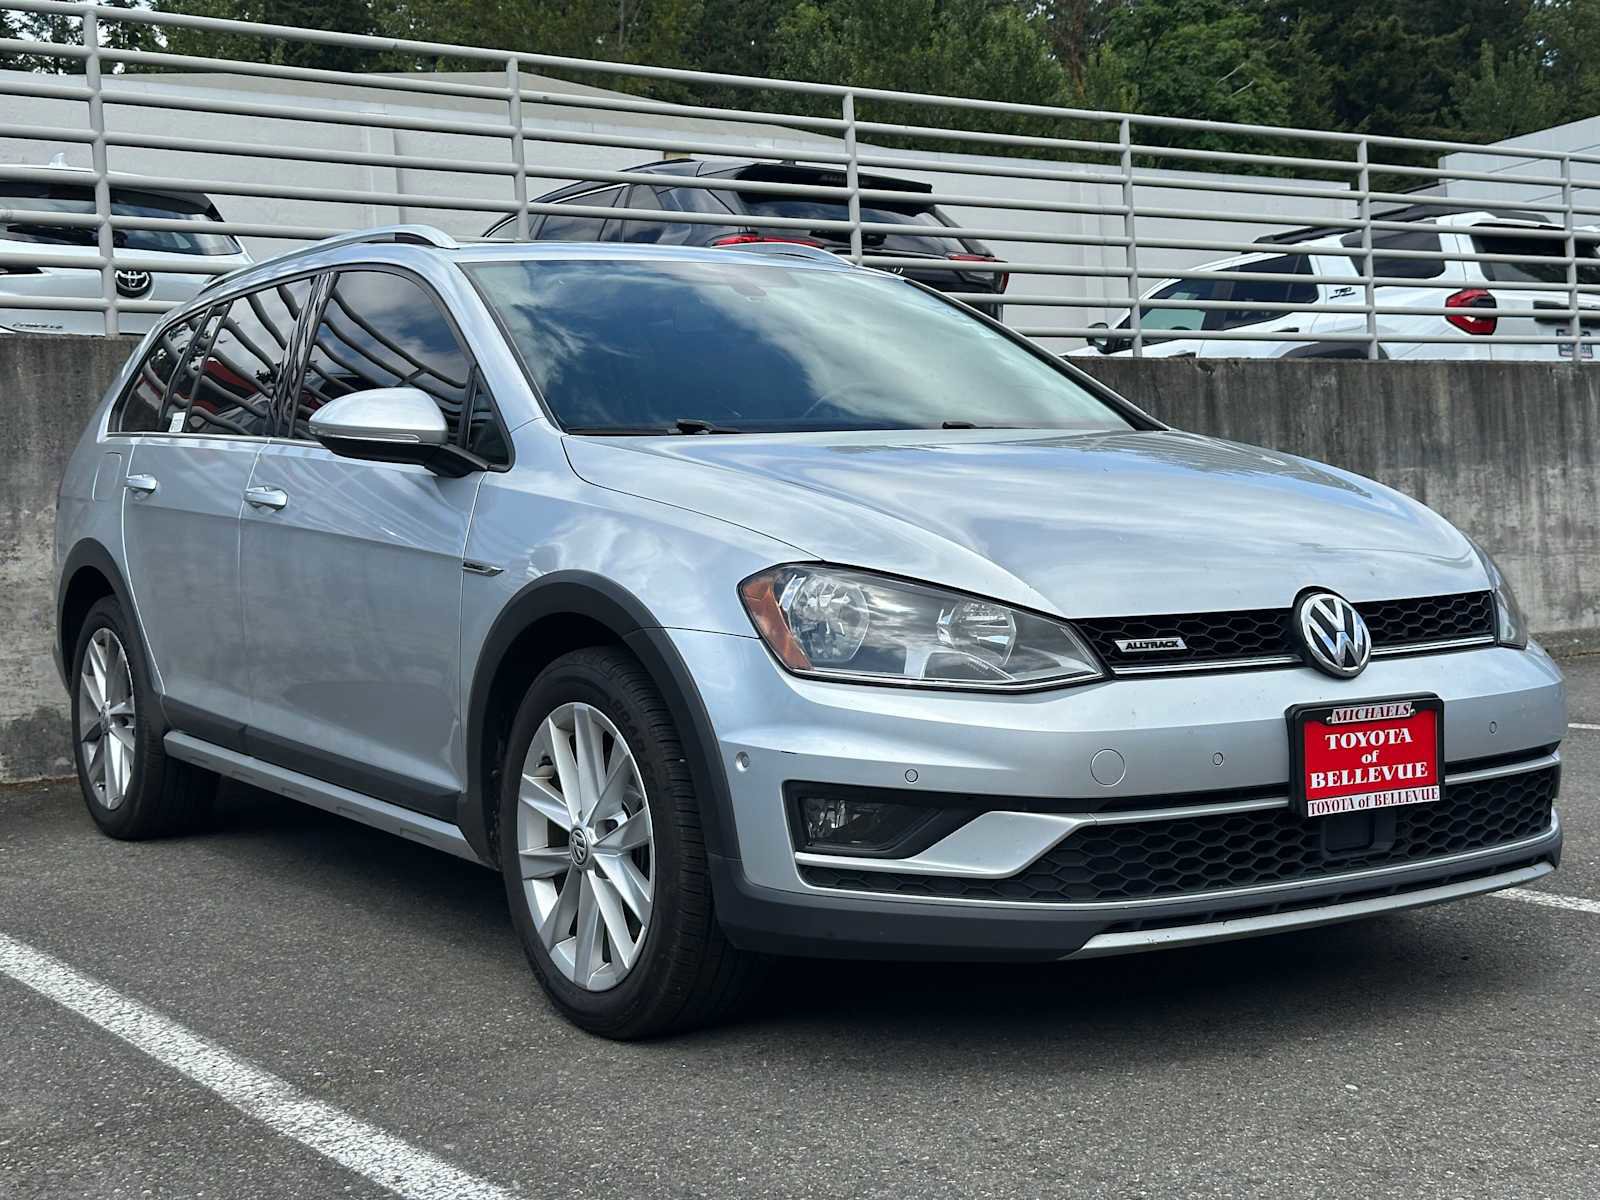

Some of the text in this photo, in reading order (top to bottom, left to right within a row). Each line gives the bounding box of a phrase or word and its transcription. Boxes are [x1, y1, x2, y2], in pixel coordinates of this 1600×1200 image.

[1125, 640, 1180, 650] ALLTRACK
[1334, 703, 1410, 722] MICHAELS
[1325, 727, 1413, 750] TOYOTA
[1361, 750, 1379, 764] of
[1310, 761, 1428, 789] BELLEVUE
[1309, 787, 1438, 815] TOYOTA of BELLEVUE
